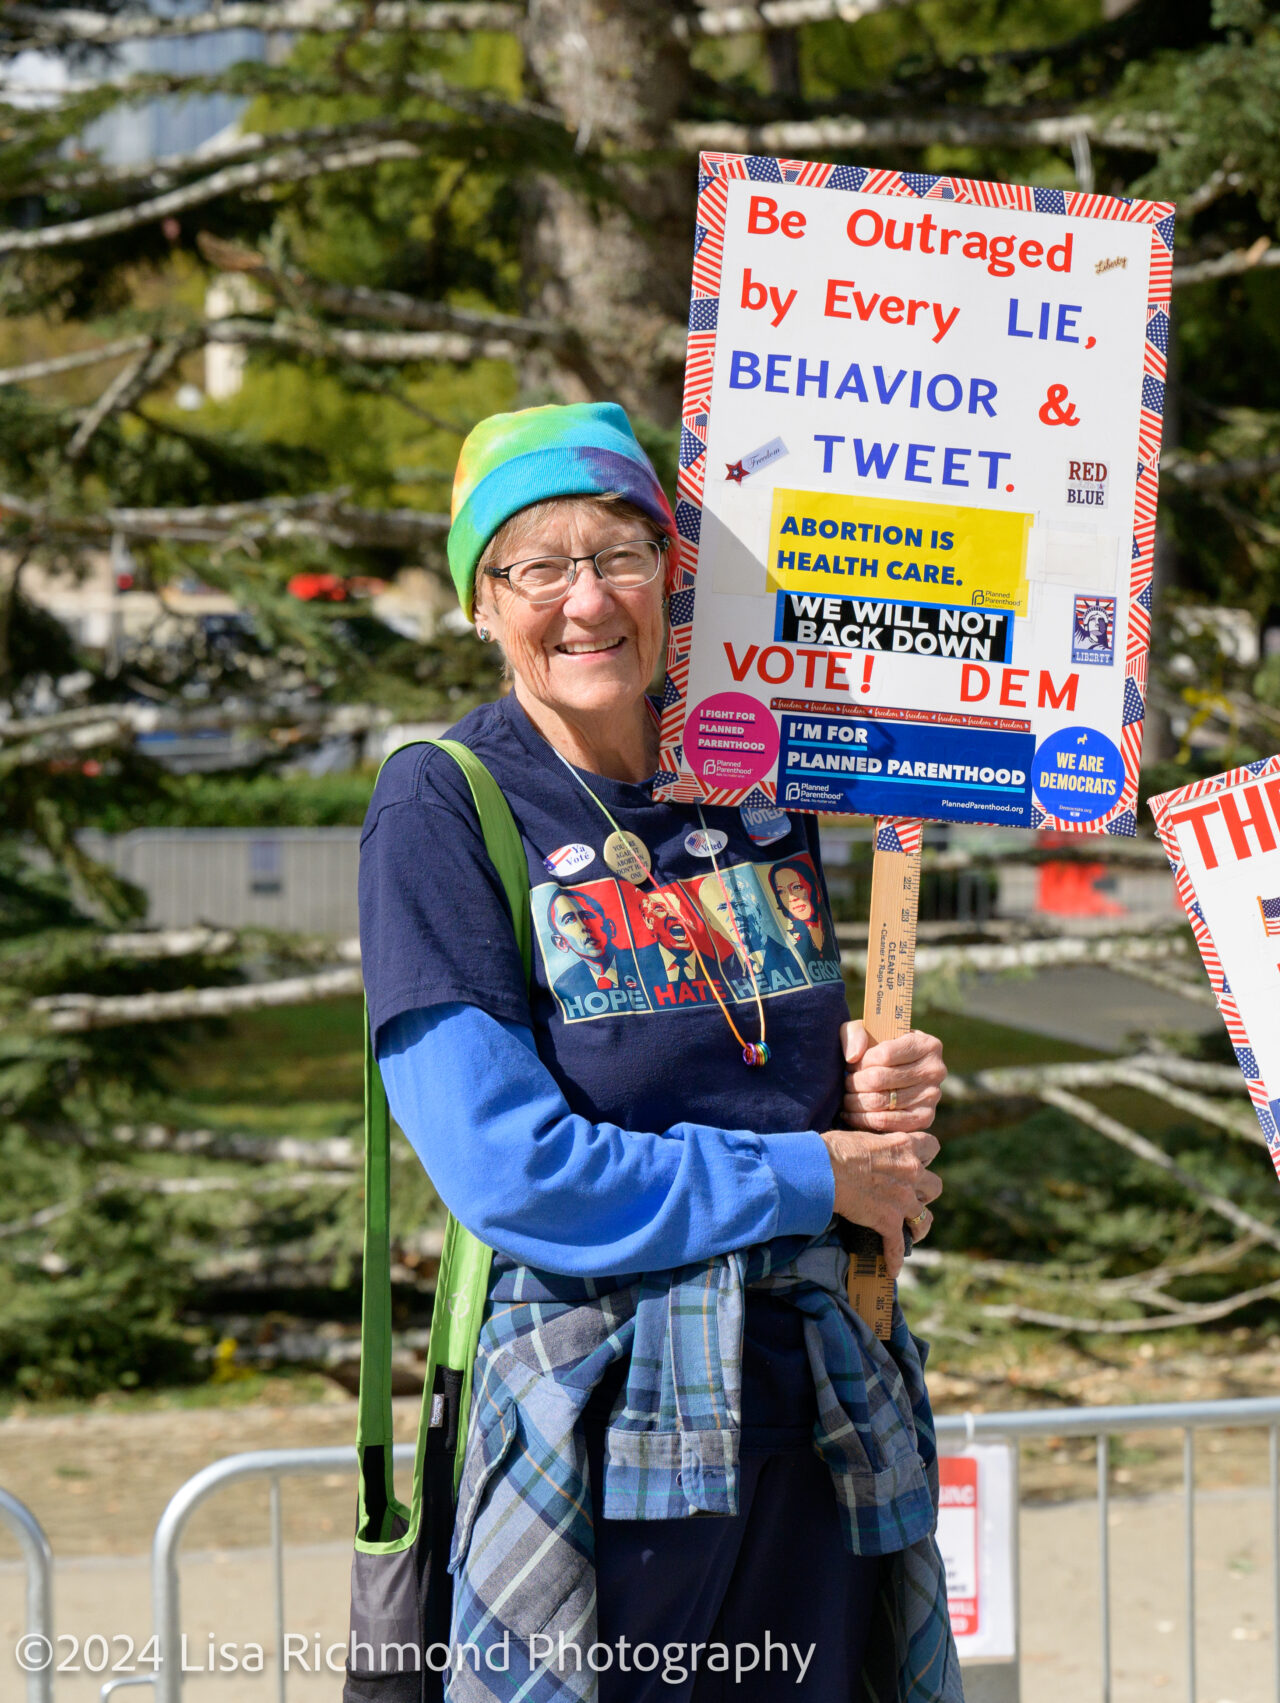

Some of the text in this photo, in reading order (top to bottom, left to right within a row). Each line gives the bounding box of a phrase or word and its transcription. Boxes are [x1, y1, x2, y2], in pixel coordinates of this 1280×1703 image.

[747, 196, 1074, 277] Be Outraged
[740, 268, 1097, 349] by Every LIE,
[729, 350, 1081, 426] BEHAVIOR &
[749, 448, 780, 469] Freedom
[813, 434, 1015, 493] TWEET.
[1068, 461, 1108, 482] RED
[1067, 489, 1104, 505] BLUE
[780, 516, 955, 550] ABORTION IS
[776, 550, 963, 587] HEALTH CARE.
[985, 590, 1010, 598] Planned
[985, 597, 1021, 606] Parenthood
[790, 594, 1004, 637] WE WILL NOT
[797, 620, 992, 661] BACK DOWN
[1076, 652, 1110, 663] LIBERTY
[723, 641, 1079, 712] VOTE! DEM
[700, 709, 756, 720] I FIGHT FOR
[699, 724, 744, 734] PLANNED
[789, 722, 868, 744] I'M FOR
[698, 738, 765, 751] PARENTHOOD
[716, 760, 741, 768] Planned
[716, 766, 752, 775] Parenthood
[786, 751, 1026, 785] PLANNED PARENTHOOD
[1056, 752, 1105, 773] WE ARE
[801, 783, 829, 792] Planned
[1040, 771, 1116, 796] DEMOCRATS
[801, 790, 842, 800] Parenthood
[941, 799, 1024, 814] PlannedParenthood.org
[1059, 804, 1092, 814] Democrats.org
[571, 845, 586, 854] Ya
[903, 876, 912, 890] 22
[901, 908, 909, 923] 23
[899, 941, 907, 954] 24
[877, 964, 885, 985] Rags
[886, 941, 896, 990] CLEAN UP
[732, 966, 804, 998] HEAL
[897, 973, 905, 987] 25
[566, 988, 647, 1018] HOPE
[653, 980, 727, 1006] HATE
[875, 990, 884, 1015] Gloves
[895, 1005, 904, 1019] 26
[876, 1296, 884, 1310] 35
